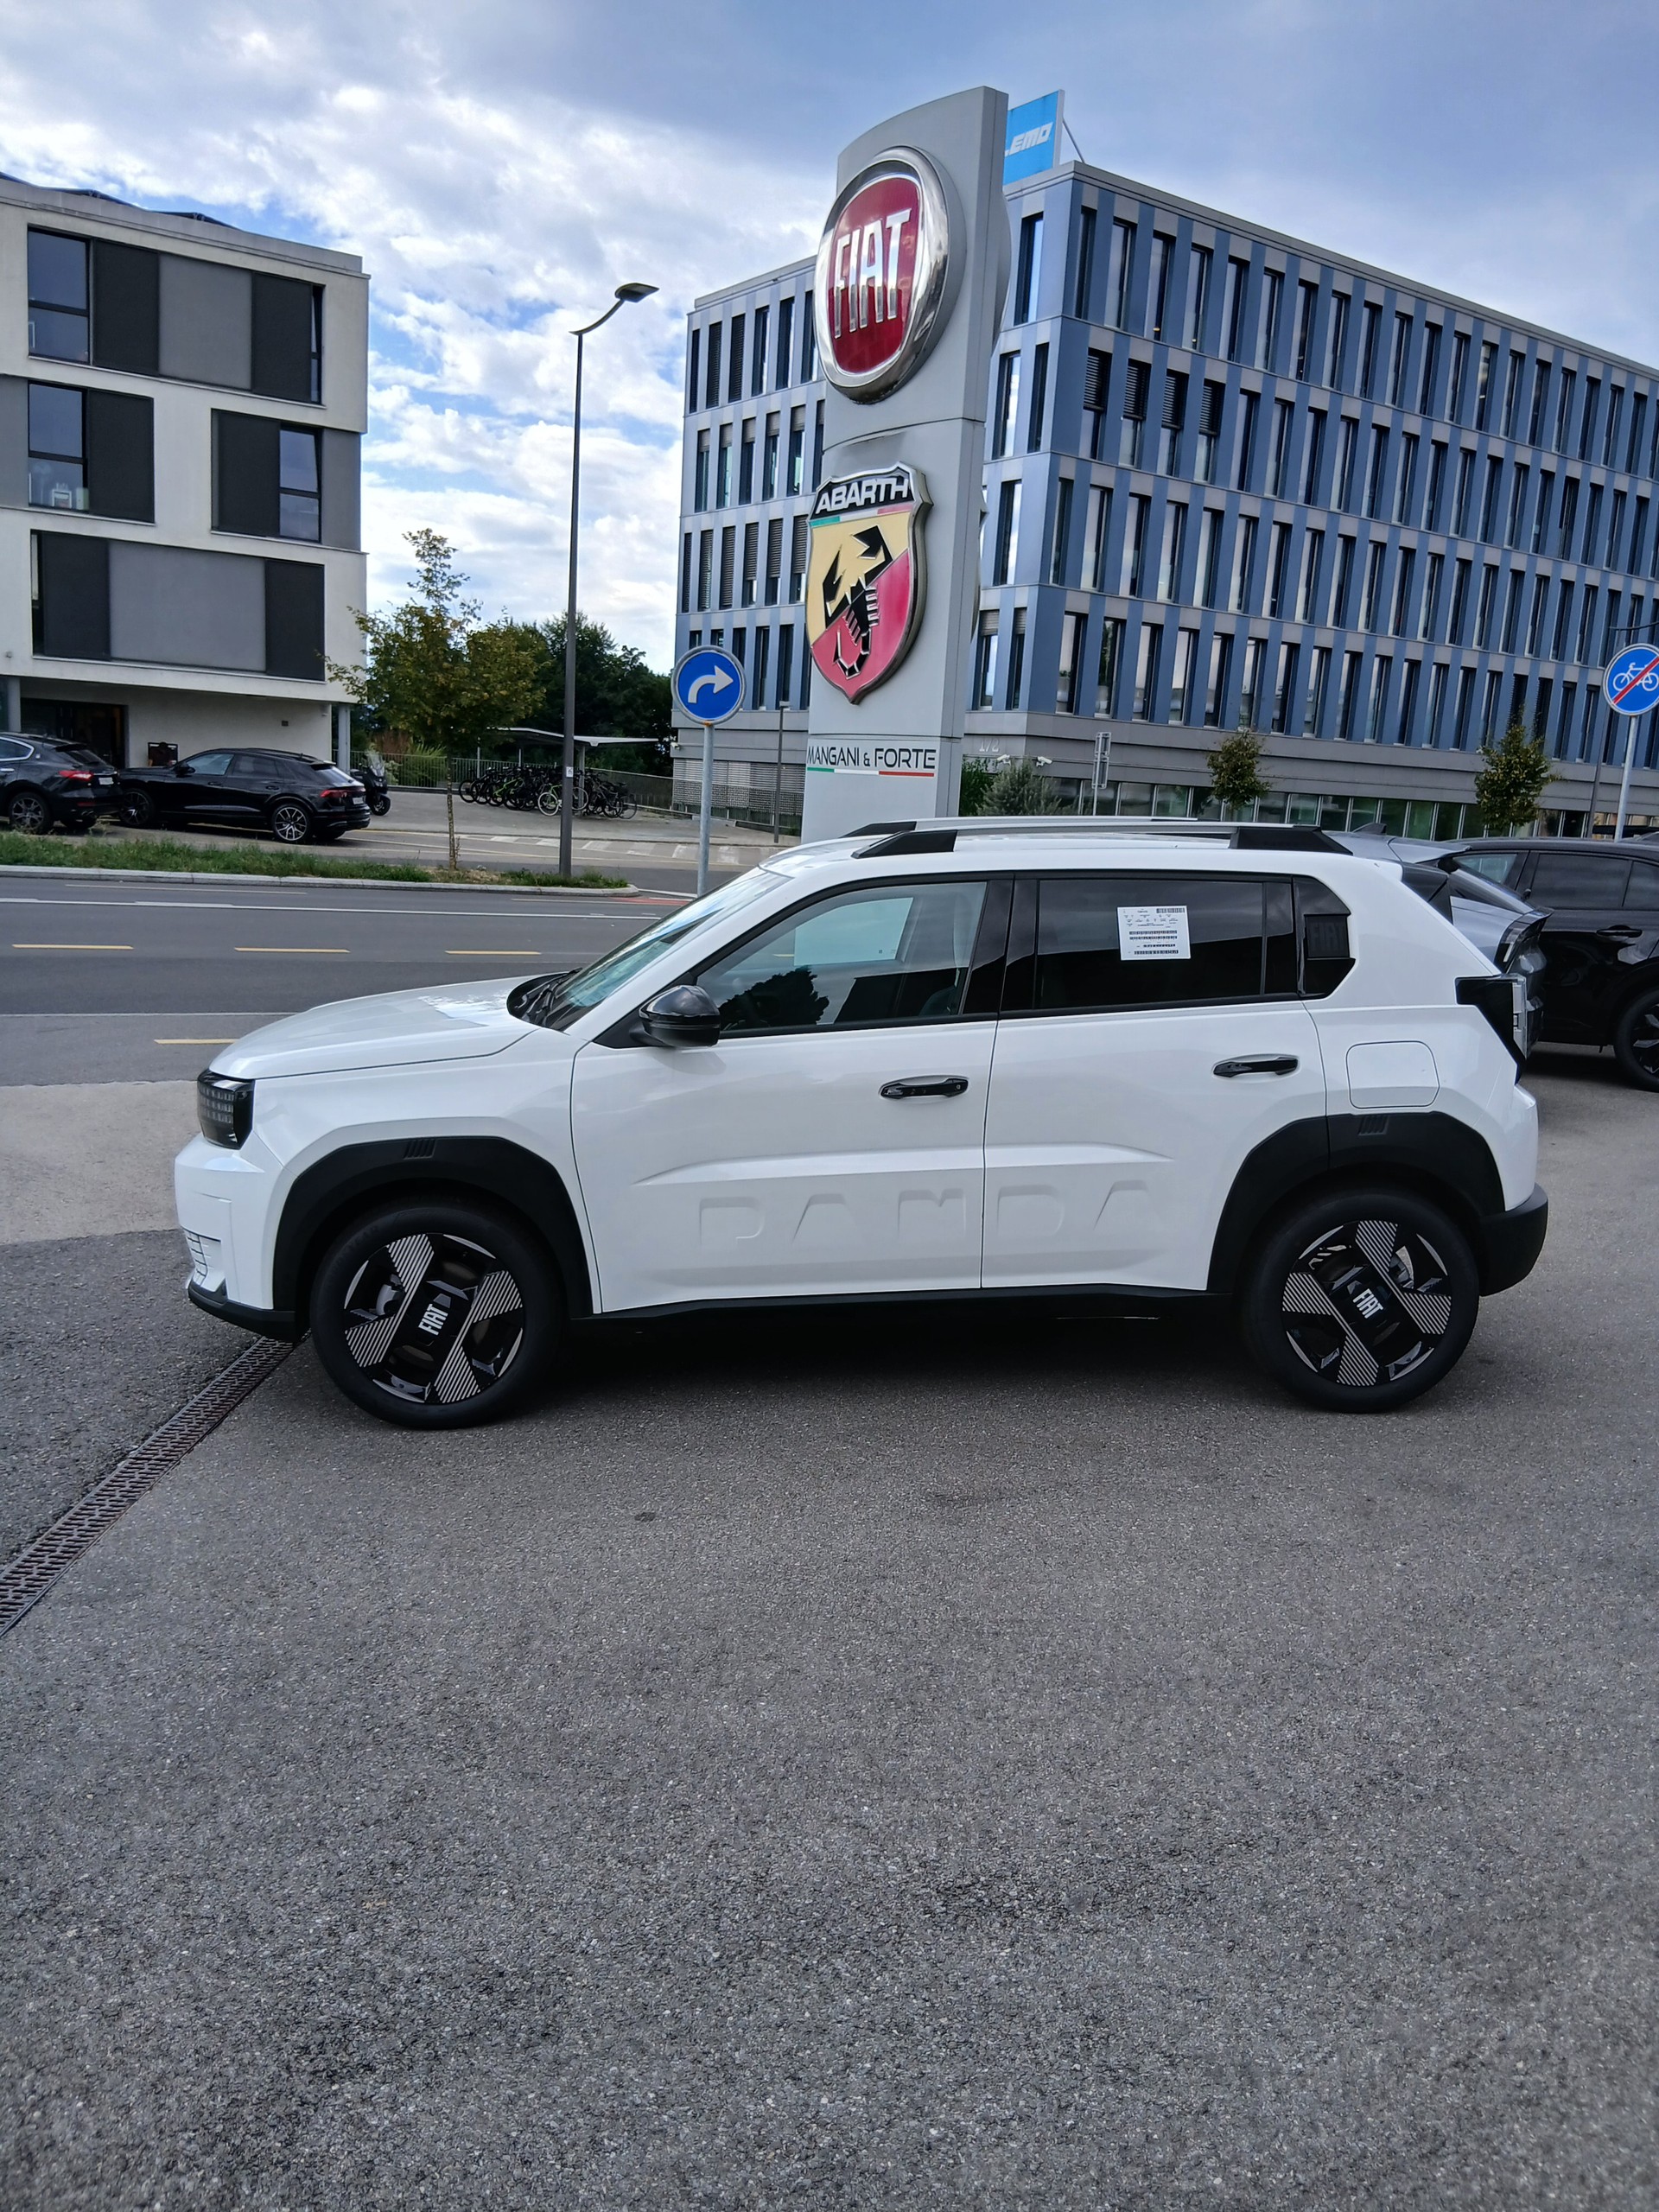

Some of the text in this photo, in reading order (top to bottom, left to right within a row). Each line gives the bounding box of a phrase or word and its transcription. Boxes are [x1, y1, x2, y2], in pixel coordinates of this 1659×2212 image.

[1005, 122, 1053, 157] EMO
[834, 208, 912, 339] FIAT
[816, 478, 908, 514] ABARTH
[807, 747, 936, 769] MANGANI & FORTE
[1310, 922, 1346, 951] FIAT
[697, 1179, 1161, 1245] PANDA
[418, 1303, 448, 1336] FIAT
[1352, 1288, 1384, 1319] FIAT
